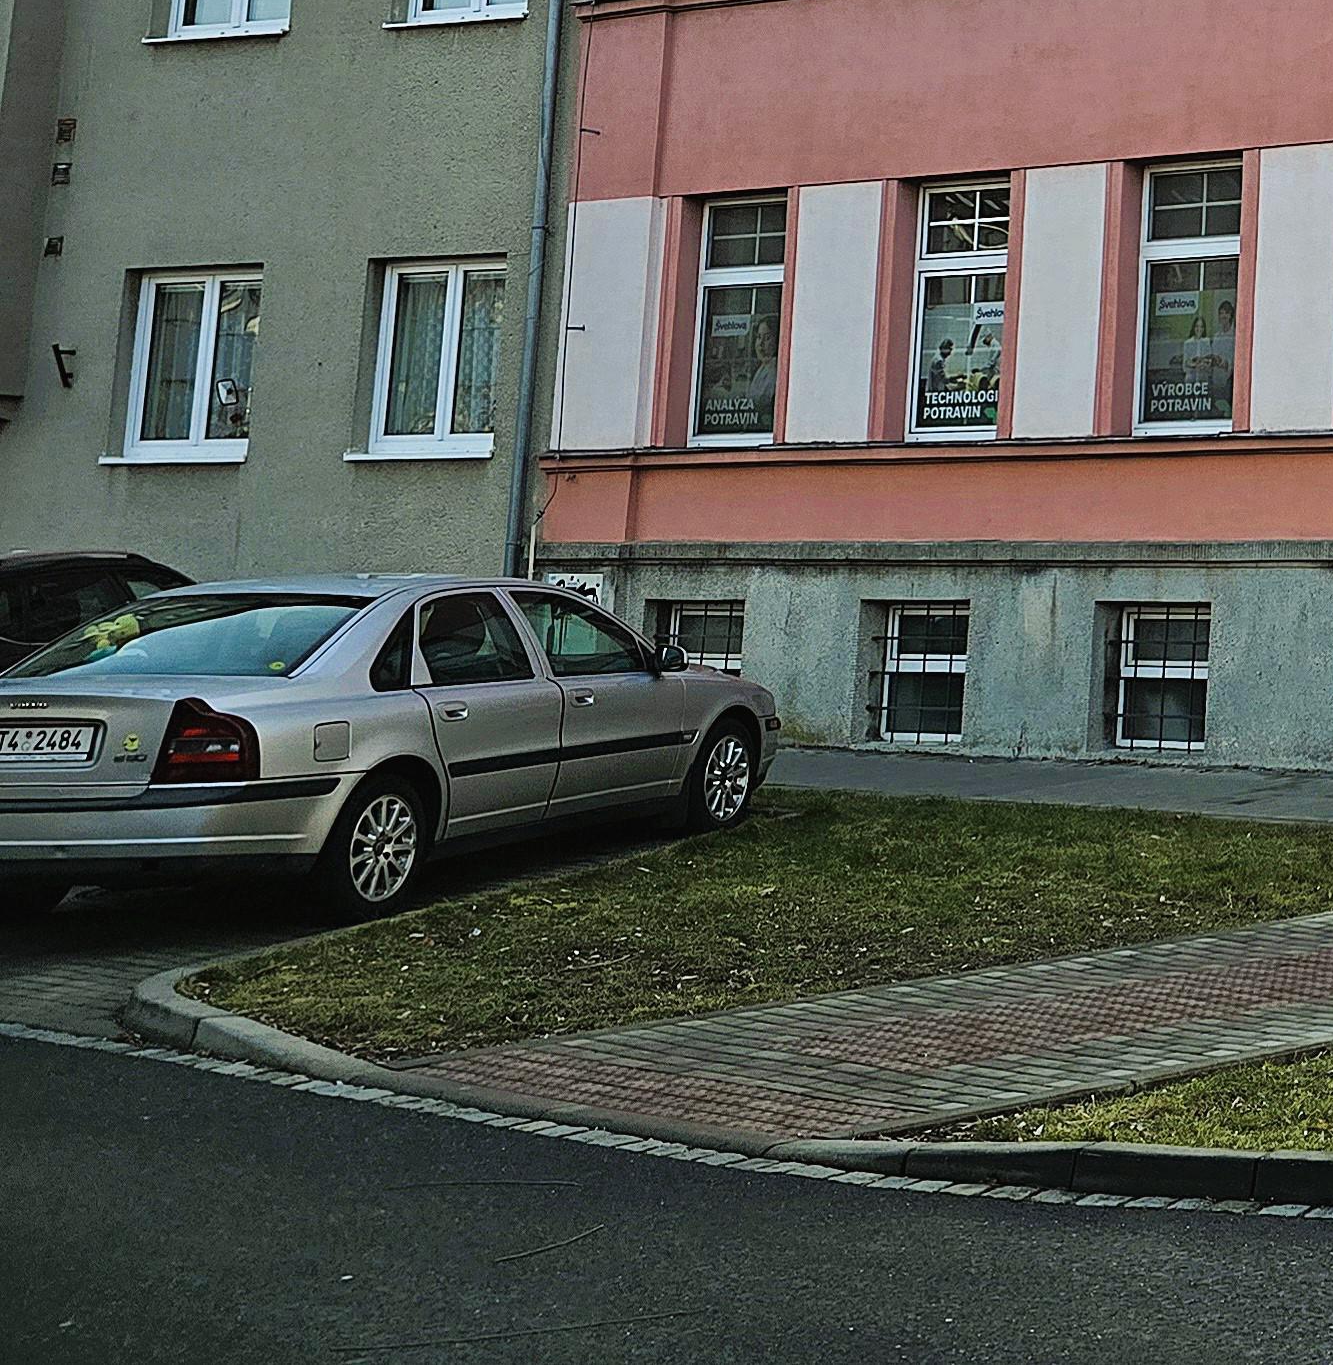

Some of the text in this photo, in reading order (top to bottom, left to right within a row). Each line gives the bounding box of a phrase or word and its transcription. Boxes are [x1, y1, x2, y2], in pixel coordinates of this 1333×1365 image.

[1159, 297, 1196, 311] Švehlova
[1151, 381, 1209, 397] VÝROBCE
[705, 395, 755, 411] ANALÝZA
[1150, 397, 1212, 413] POTRAVIN
[704, 412, 759, 425] POTRAVIN
[923, 406, 981, 420] POTRAVIN
[33, 729, 82, 751] 2484
